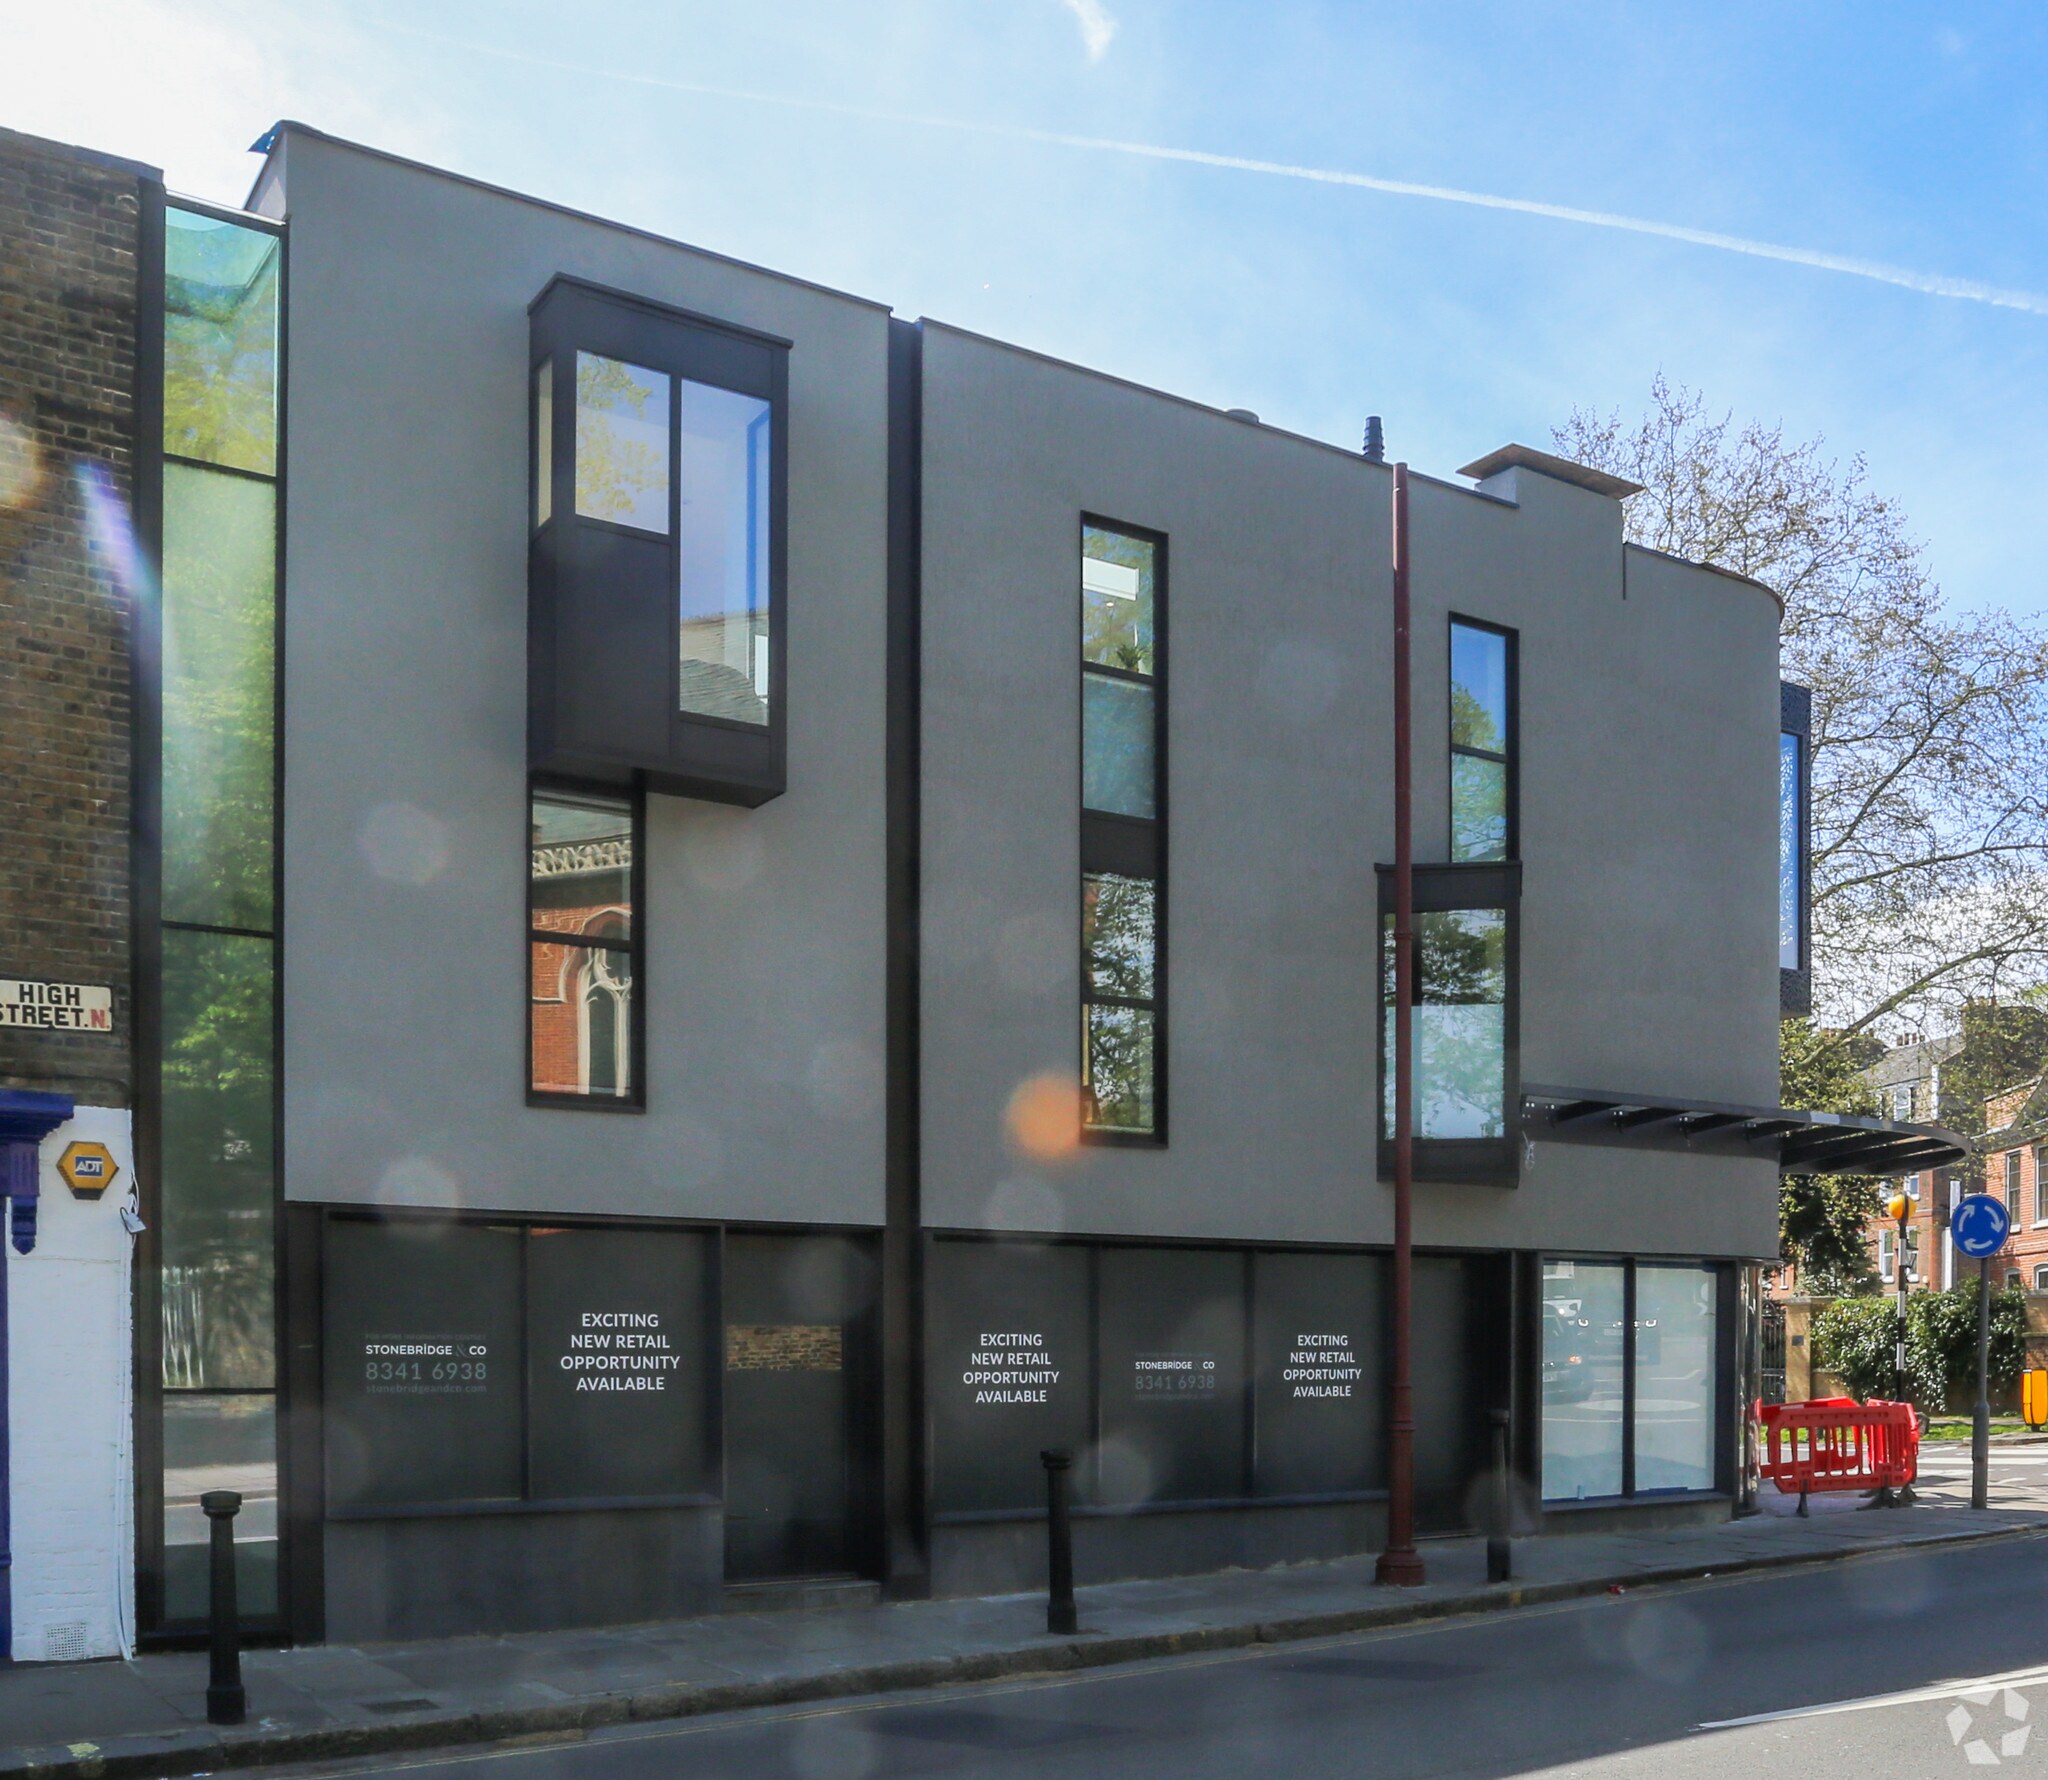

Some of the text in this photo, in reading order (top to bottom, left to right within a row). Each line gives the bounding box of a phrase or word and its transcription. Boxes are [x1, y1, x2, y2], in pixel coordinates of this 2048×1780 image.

[19, 984, 80, 1006] HIGH
[75, 1160, 103, 1173] ADT
[582, 1312, 659, 1327] EXCITING
[571, 1334, 670, 1348] NEW RETAIL
[981, 1333, 1042, 1347] EXCITING
[1297, 1334, 1348, 1347] EXCITING
[365, 1343, 453, 1356] STONEBRIDGE
[469, 1345, 487, 1356] CO
[560, 1355, 681, 1370] OPPORTUNITY
[971, 1352, 1051, 1365] NEW RETAIL
[1290, 1351, 1355, 1363] NEW RETAIL
[366, 1361, 487, 1380] 8341 6938
[1135, 1360, 1192, 1370] STONEBRIDGE
[1202, 1361, 1215, 1369] CO
[963, 1370, 1059, 1385] OPPORTUNITY
[1283, 1368, 1361, 1381] OPPORTUNITY
[576, 1376, 665, 1391] AVAILABLE
[1135, 1374, 1215, 1390] 8341 6938
[976, 1389, 1047, 1403] AVAILABLE
[1293, 1385, 1352, 1398] AVAILABLE
